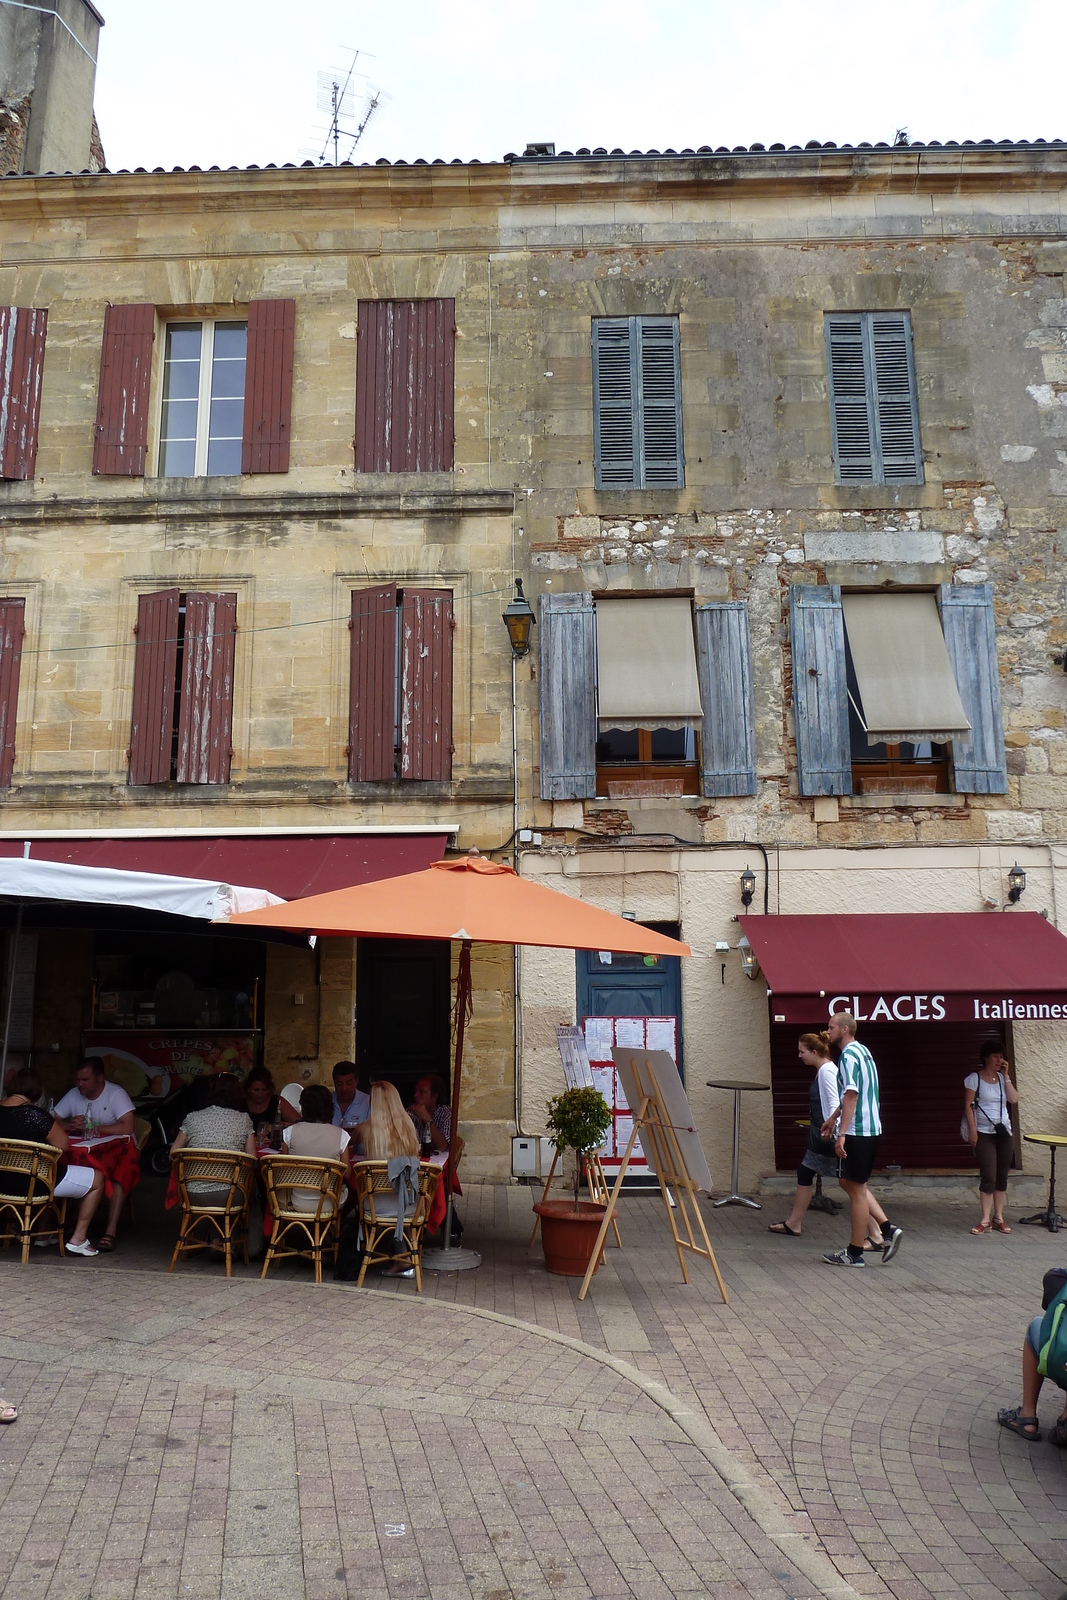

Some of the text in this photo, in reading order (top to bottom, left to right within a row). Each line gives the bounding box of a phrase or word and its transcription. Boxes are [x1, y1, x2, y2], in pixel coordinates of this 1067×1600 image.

[828, 995, 946, 1021] GLACES
[171, 1052, 190, 1061] DE
[159, 1065, 202, 1076] FRANCE
